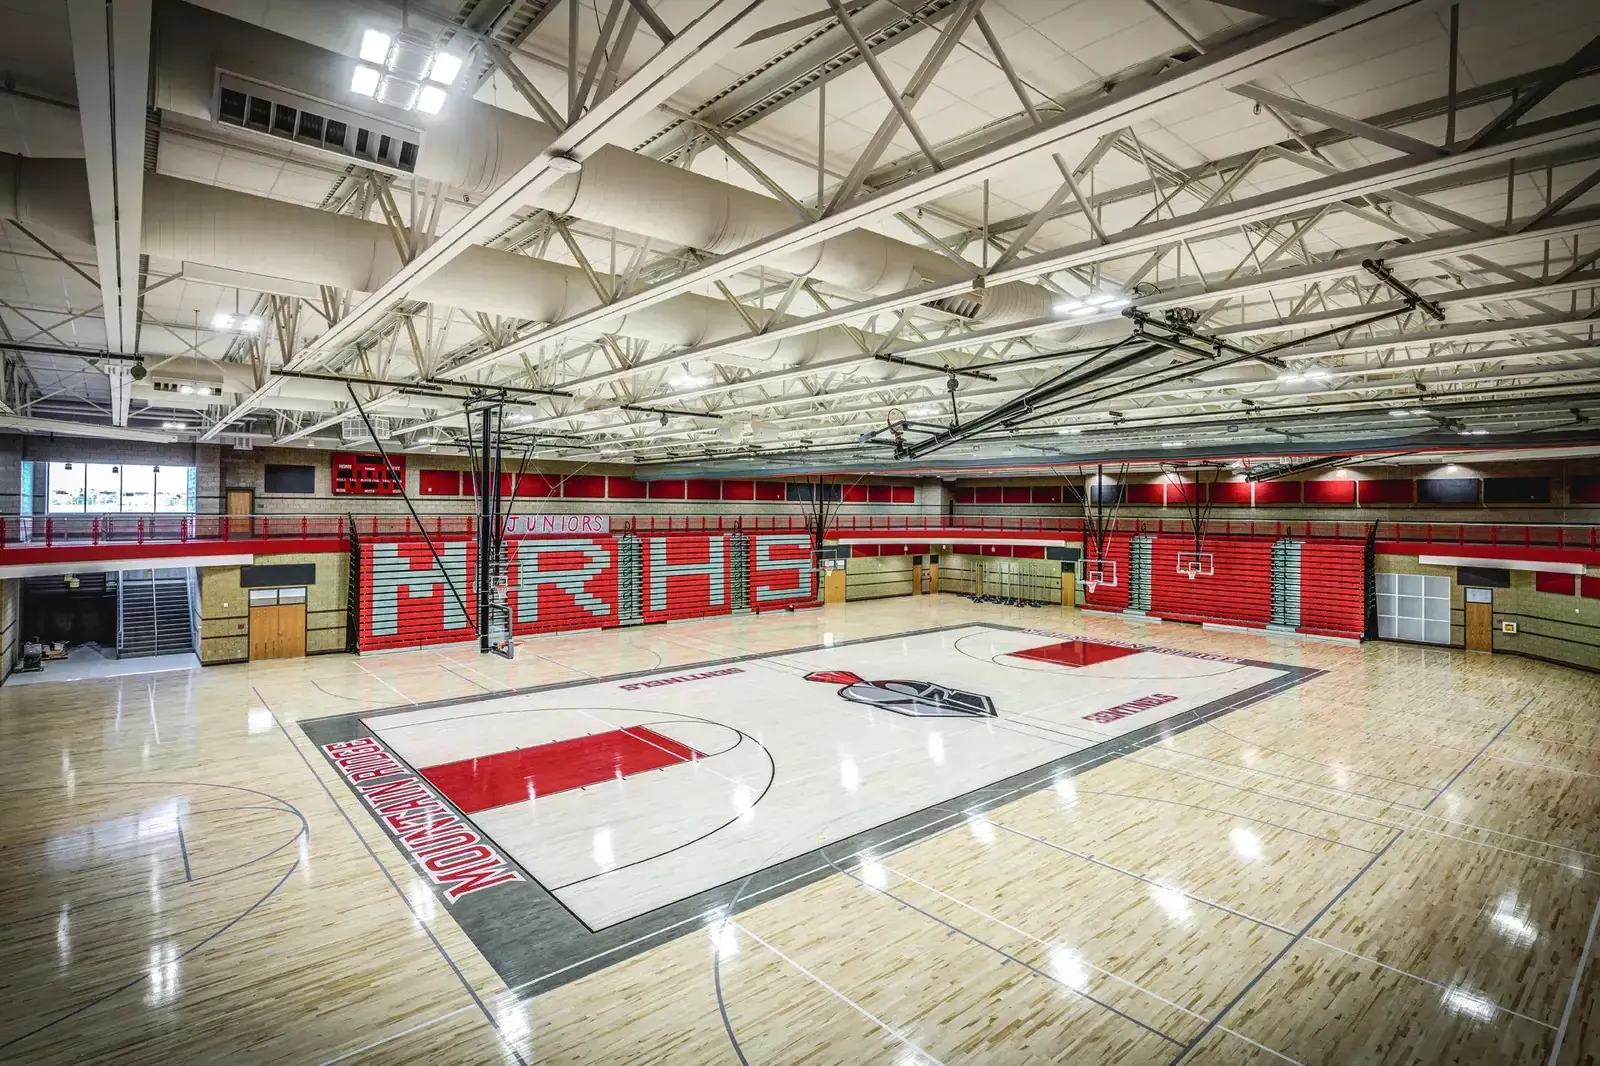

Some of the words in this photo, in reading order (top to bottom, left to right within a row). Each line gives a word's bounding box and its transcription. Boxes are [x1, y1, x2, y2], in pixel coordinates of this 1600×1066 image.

[506, 515, 603, 532] JUNIORS
[321, 737, 411, 785] RIDGE
[355, 777, 526, 904] MOUNTAIN
